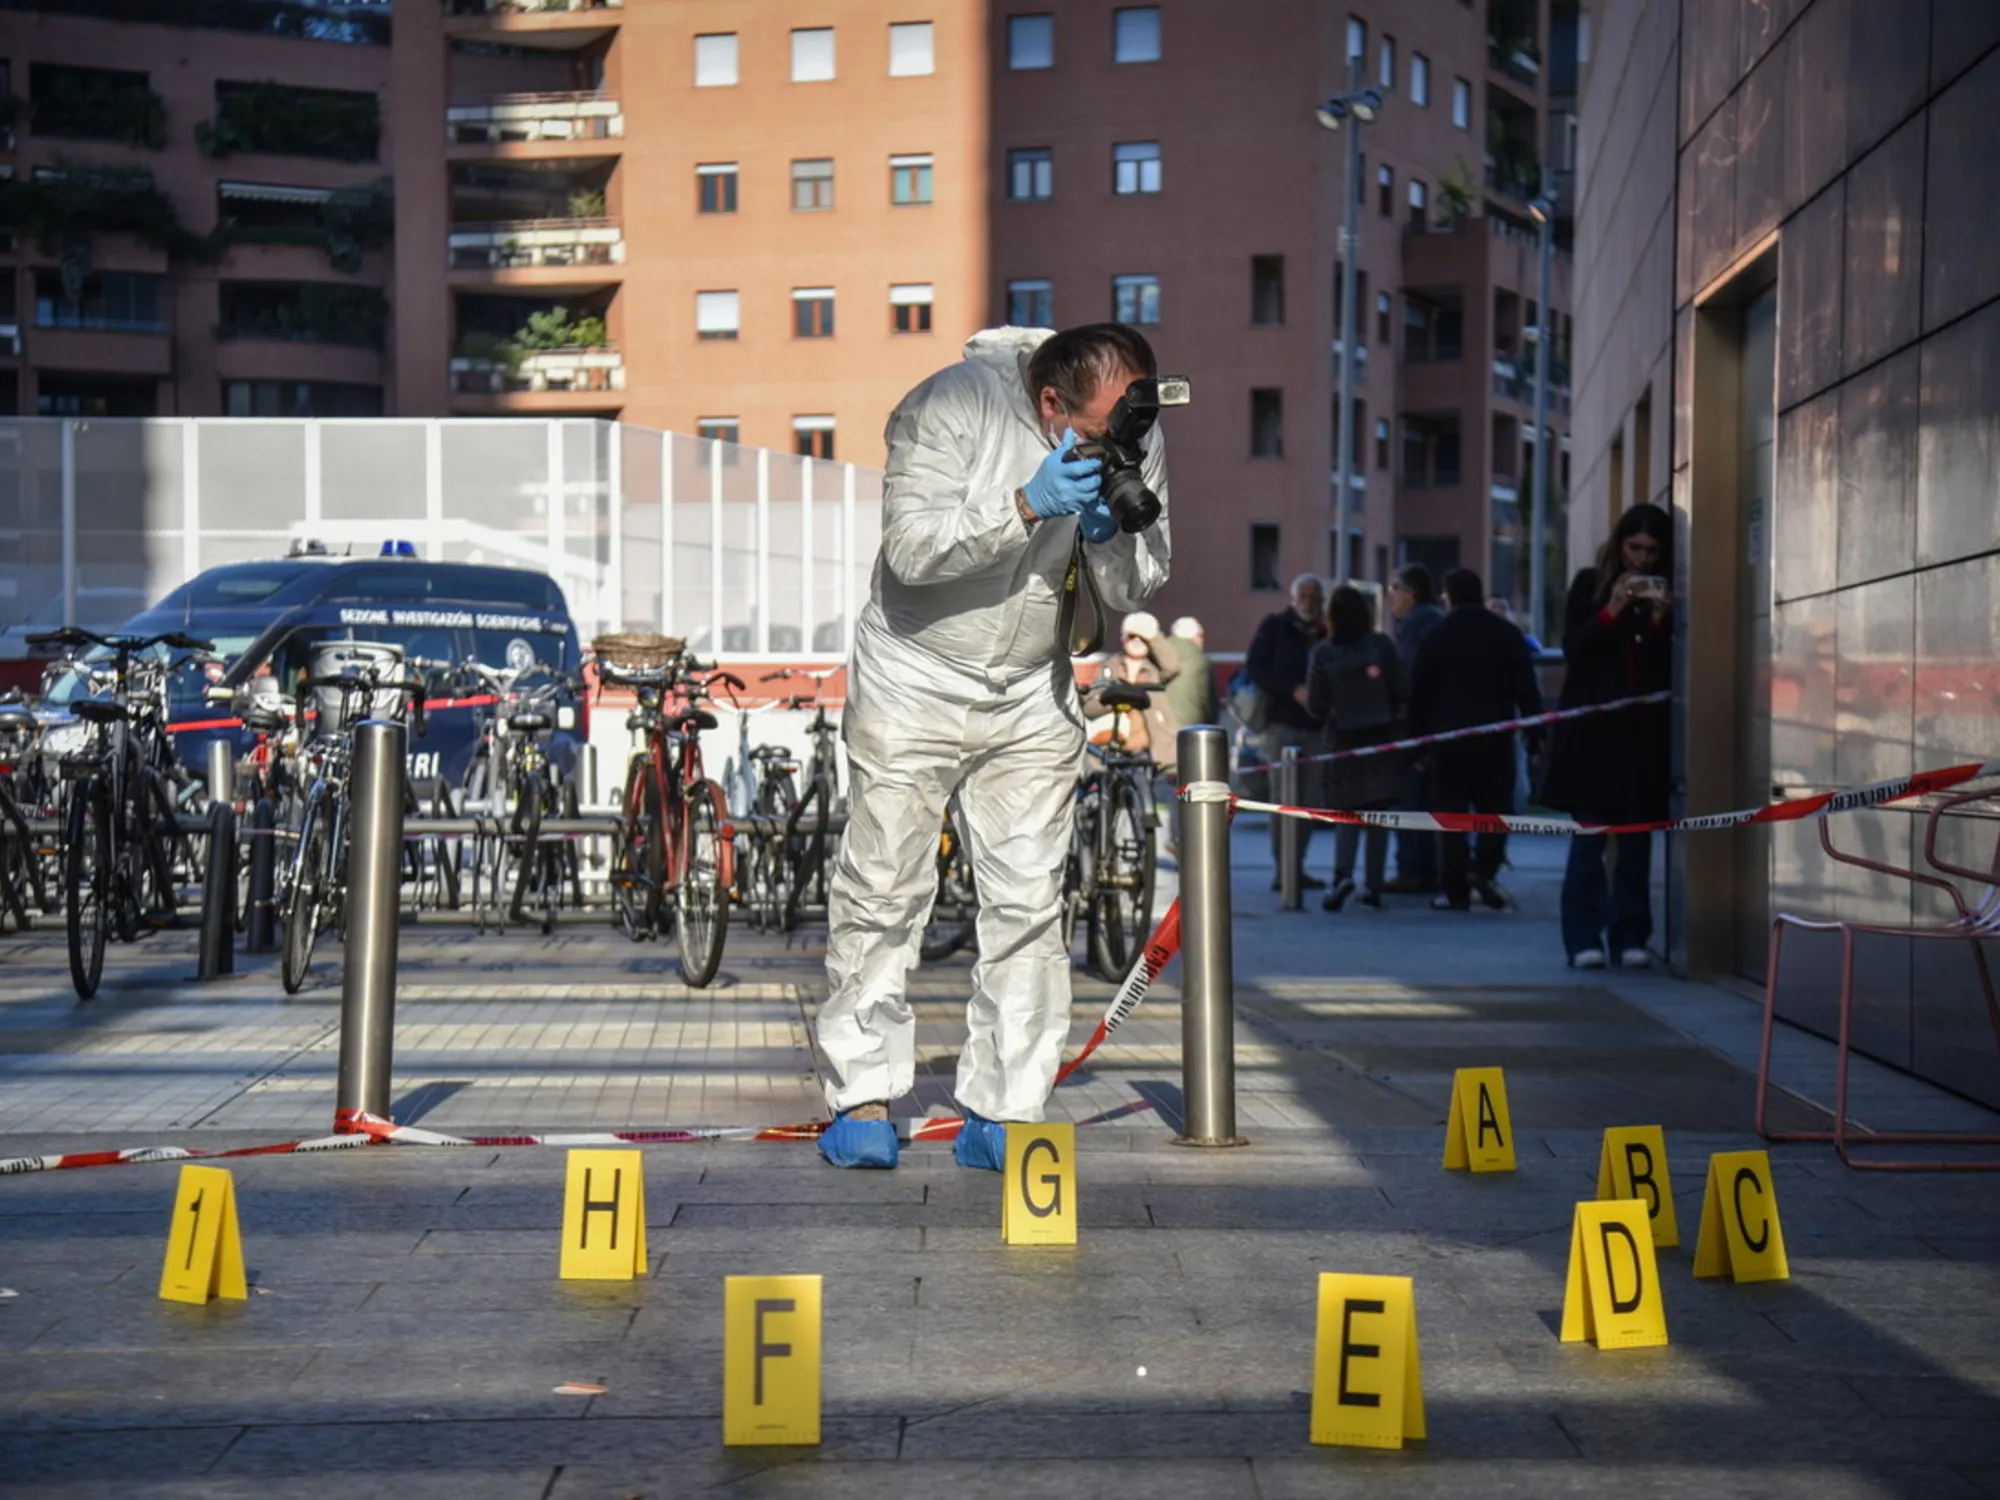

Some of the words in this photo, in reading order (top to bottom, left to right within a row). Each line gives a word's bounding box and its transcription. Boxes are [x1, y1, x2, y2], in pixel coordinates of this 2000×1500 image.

[340, 608, 389, 624] SEZIONE
[1478, 1083, 1505, 1149] A
[580, 1168, 621, 1250] H
[1021, 1137, 1061, 1218] G
[1625, 1143, 1661, 1218] B
[1733, 1167, 1769, 1254] C
[1600, 1221, 1642, 1314] D
[753, 1298, 795, 1407] F
[1338, 1299, 1385, 1408] E
